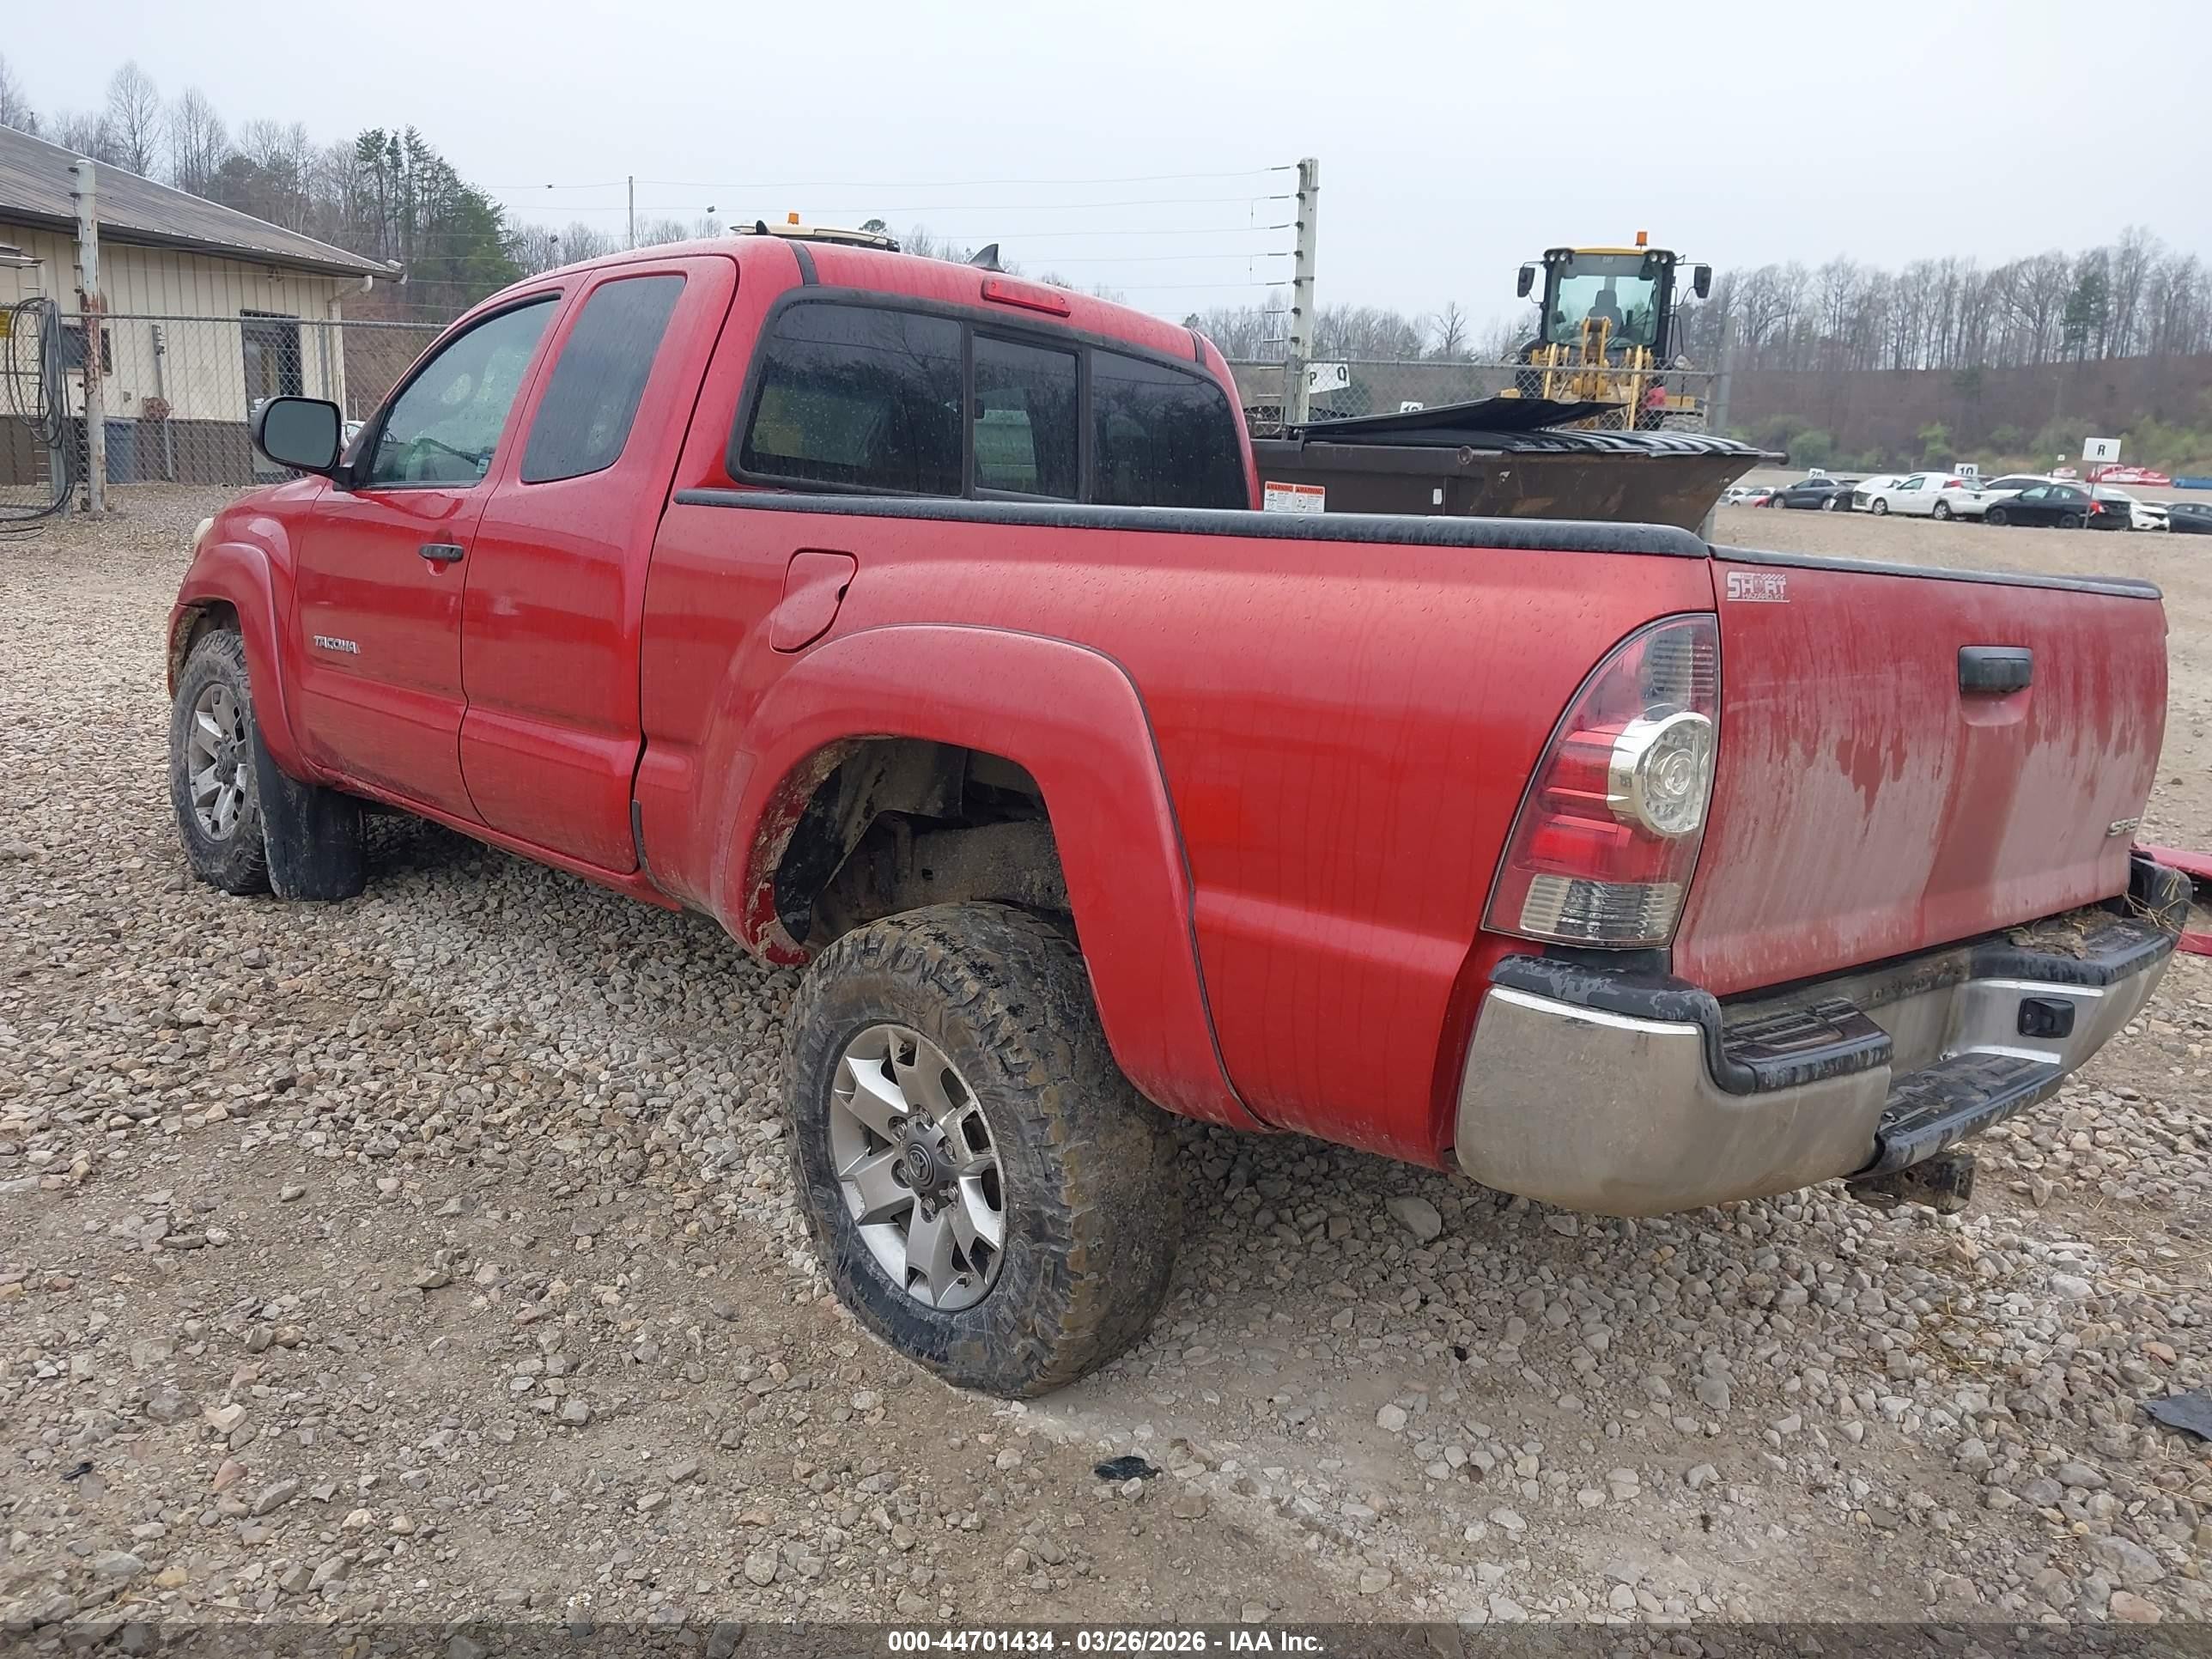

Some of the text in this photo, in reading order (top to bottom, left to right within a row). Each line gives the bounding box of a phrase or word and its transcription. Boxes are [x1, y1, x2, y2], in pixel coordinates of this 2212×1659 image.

[1337, 366, 1347, 381] Q
[2097, 444, 2106, 456] R
[313, 635, 361, 654] TACOMA
